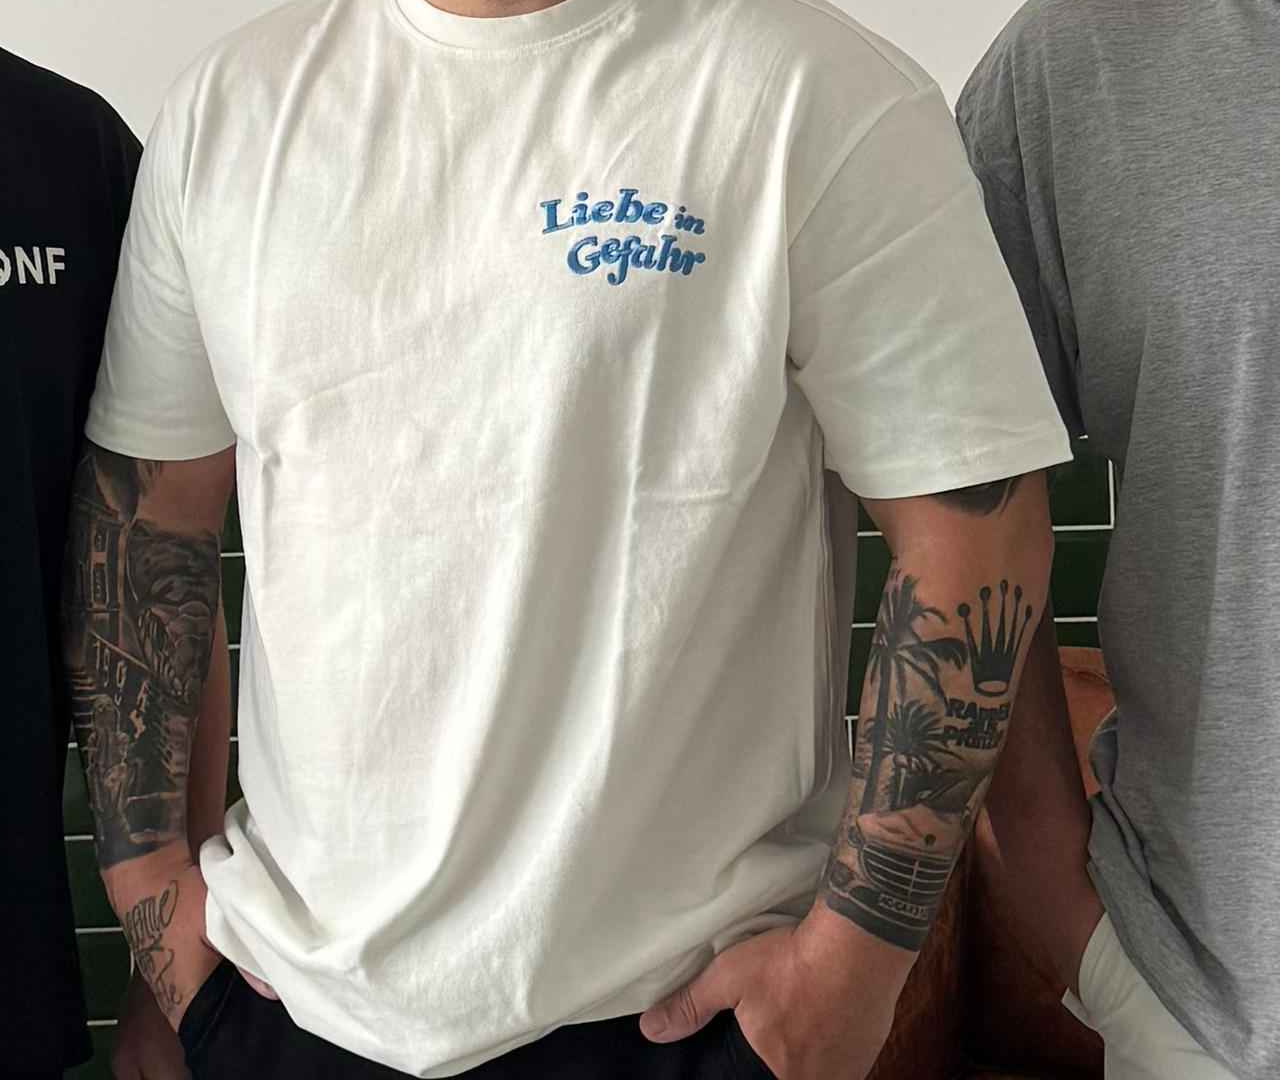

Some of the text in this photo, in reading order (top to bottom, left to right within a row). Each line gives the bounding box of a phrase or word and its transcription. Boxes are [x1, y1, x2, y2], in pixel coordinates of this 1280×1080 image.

[540, 188, 705, 235] Liebe in
[567, 234, 706, 286] Gefahr
